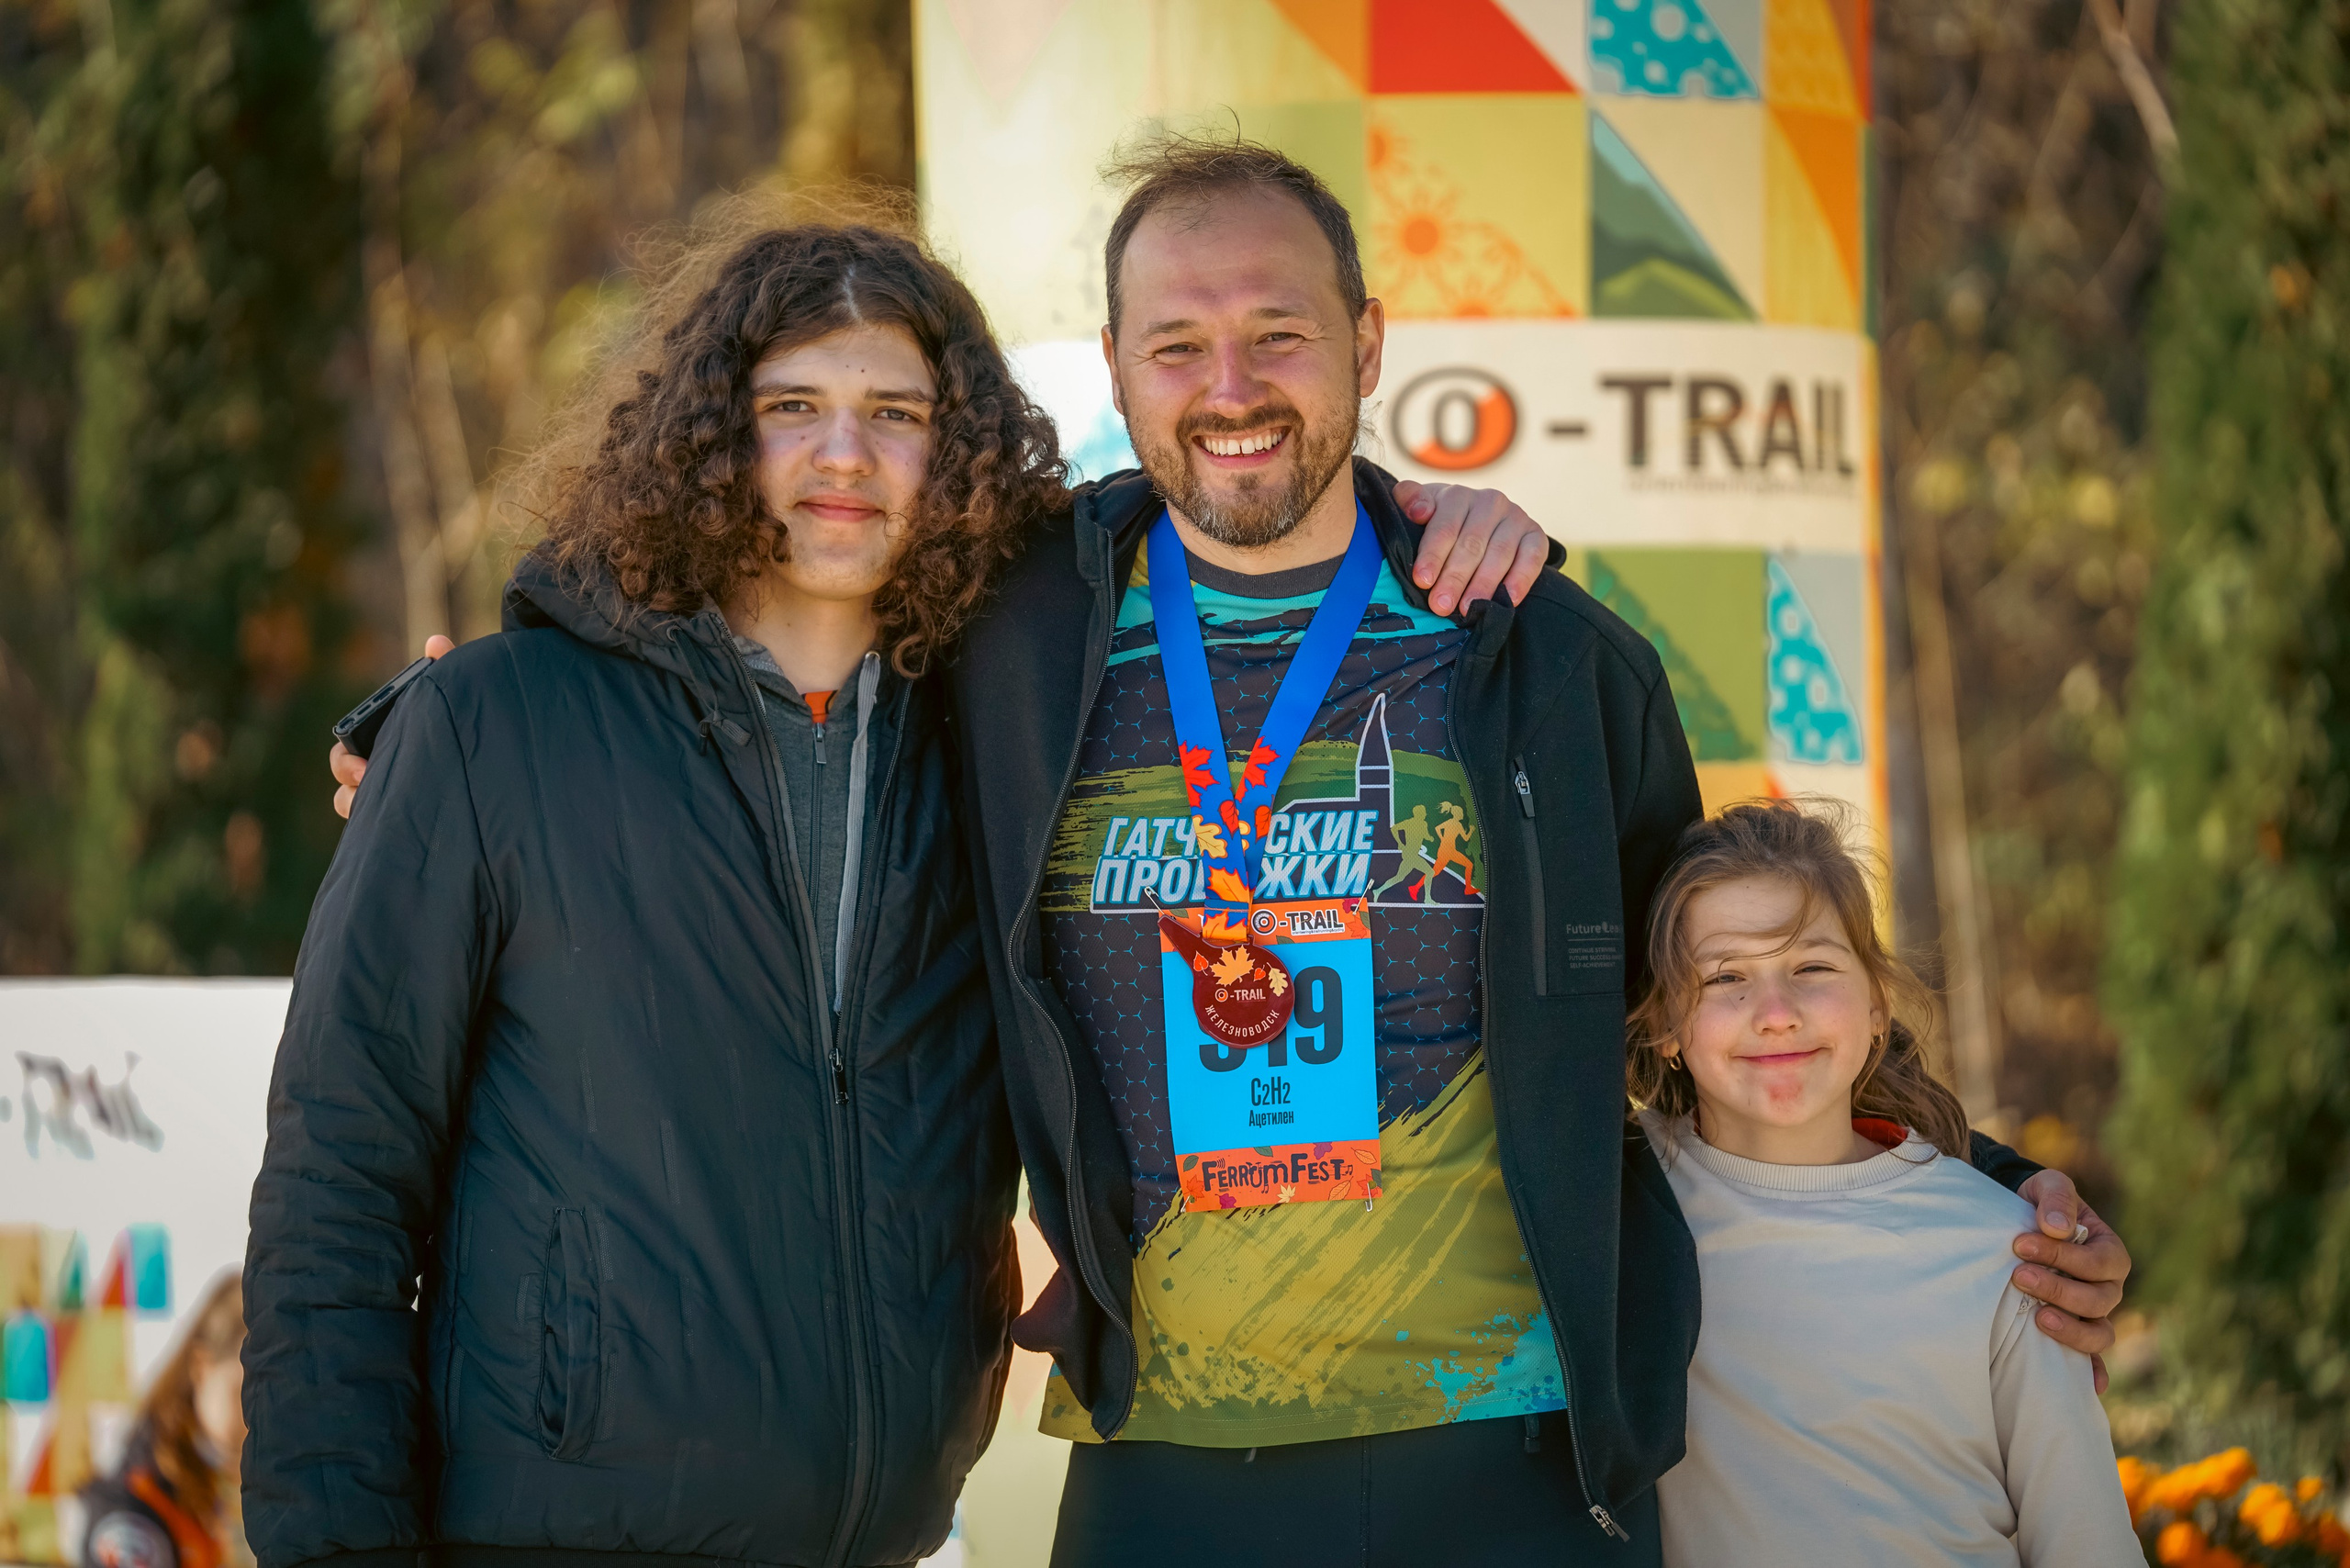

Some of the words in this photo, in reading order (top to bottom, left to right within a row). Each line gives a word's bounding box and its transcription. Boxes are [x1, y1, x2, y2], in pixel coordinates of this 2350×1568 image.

[1102, 810, 1379, 859] ГАТЧСКИЕ
[1093, 853, 1372, 905] ПРОЖКИ
[1205, 1005, 1280, 1037] ЖЕЛЕЗНОВОДСК
[1248, 1109, 1294, 1128] Ацетилен
